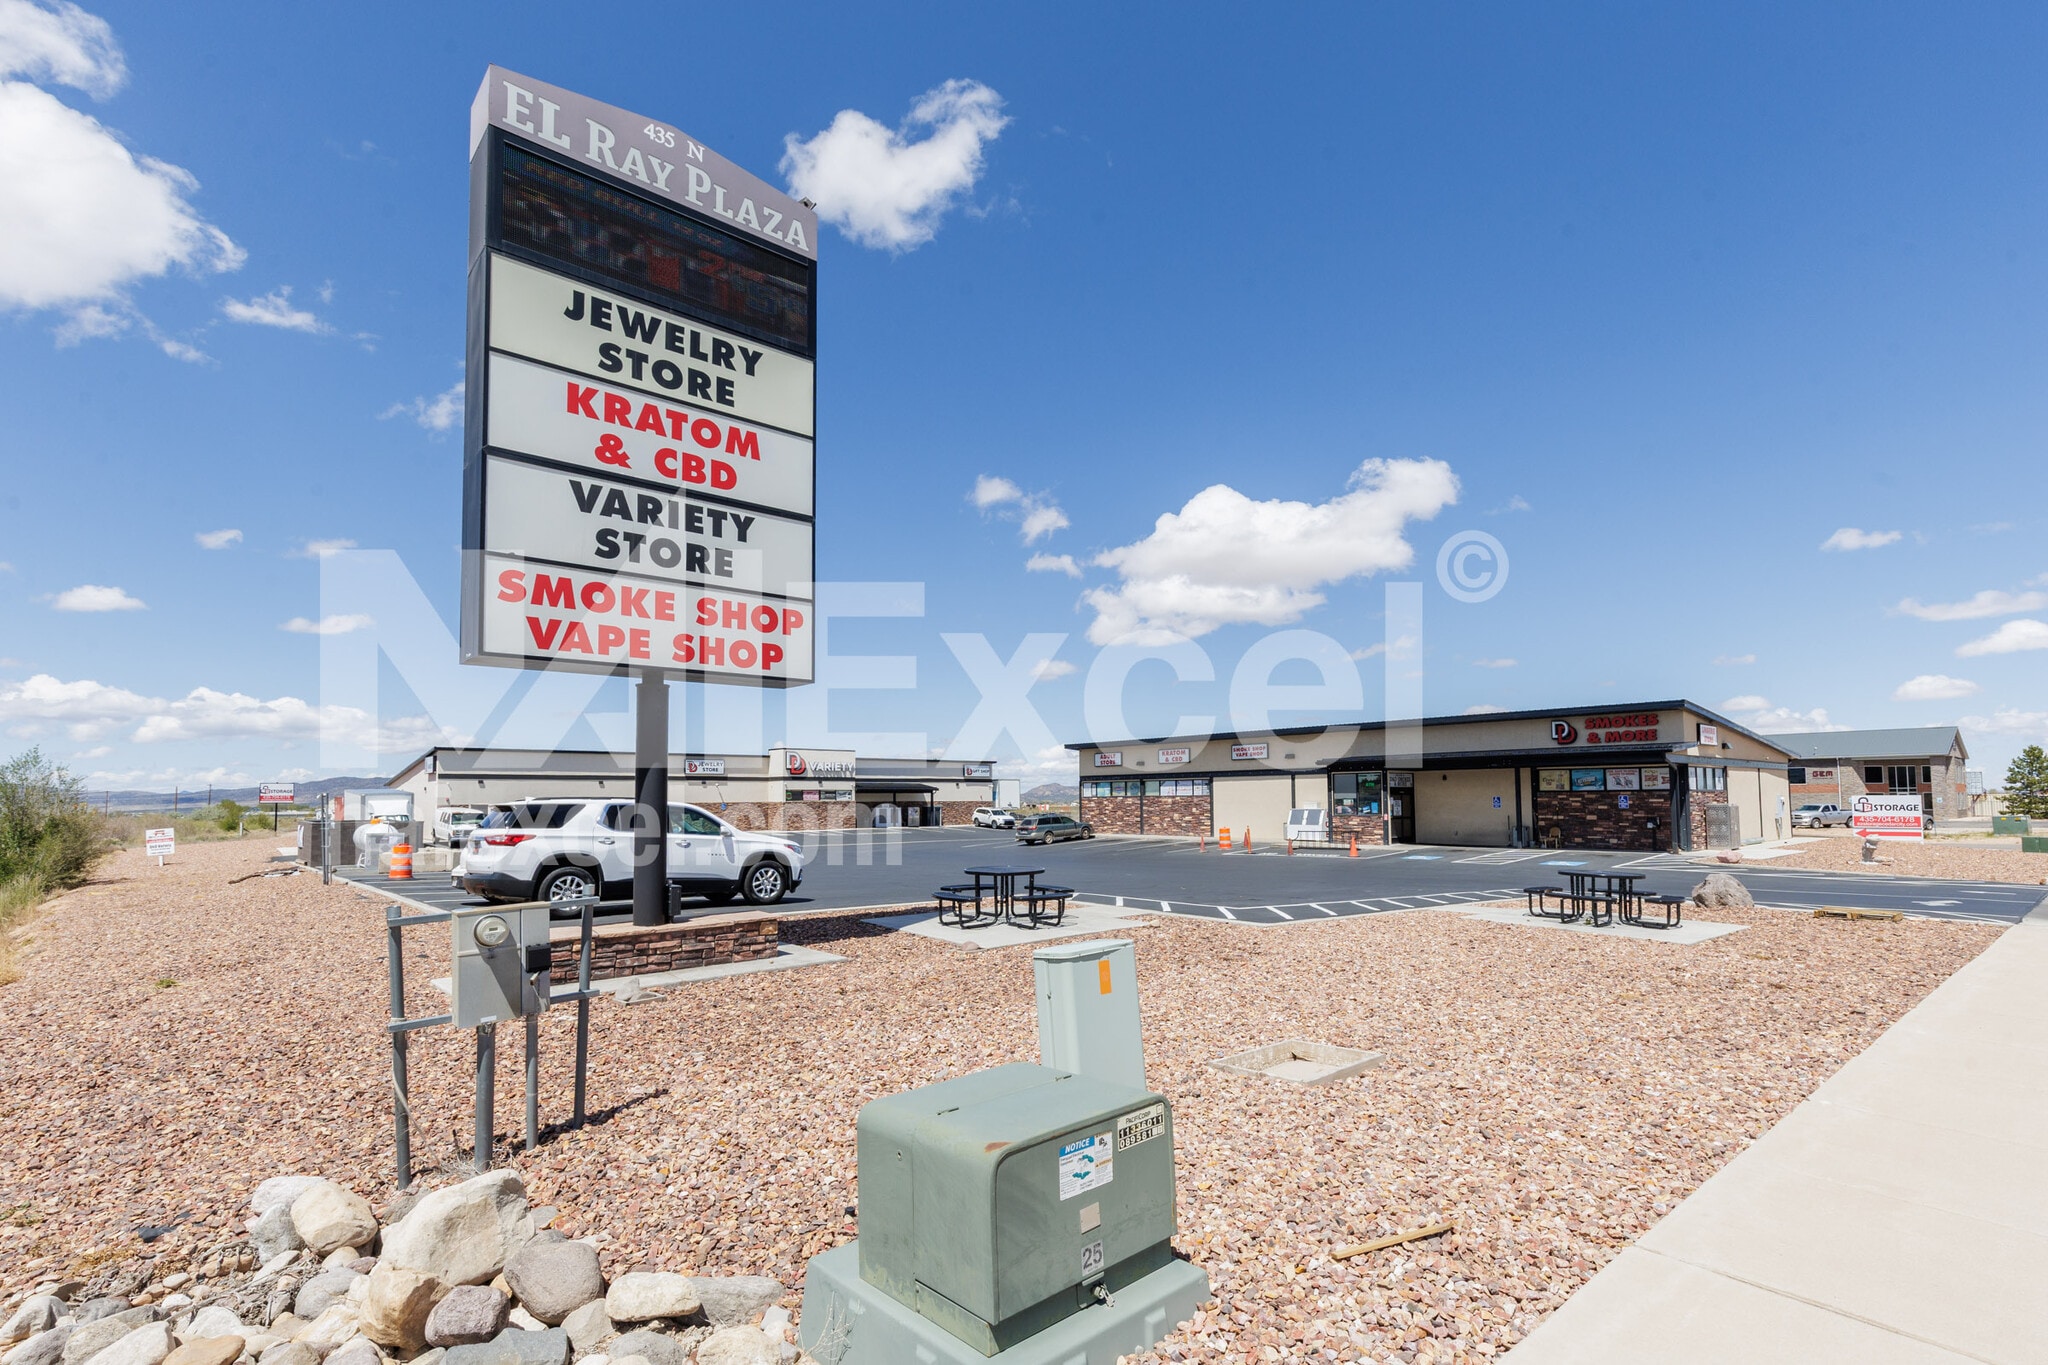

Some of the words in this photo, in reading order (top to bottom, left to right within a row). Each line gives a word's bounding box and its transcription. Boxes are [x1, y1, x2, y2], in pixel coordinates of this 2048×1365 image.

[502, 80, 571, 150] EL
[585, 117, 675, 193] RAY
[685, 163, 810, 252] PLAZA
[643, 122, 676, 148] 435
[686, 140, 705, 162] N
[563, 290, 764, 377] JEWELRY
[597, 342, 735, 407] STORE
[566, 382, 761, 461] KRATOM
[594, 433, 632, 469] &
[654, 447, 737, 491] CBD
[569, 479, 755, 543] VARIETY
[594, 528, 734, 578] STORE
[497, 568, 676, 621] SMOKE
[696, 596, 804, 636] SHOP
[525, 615, 651, 660] VAPE
[672, 633, 784, 671] SHOP
[1585, 713, 1659, 730] SMOKES
[1586, 732, 1602, 744] &
[1604, 728, 1658, 743] MORE
[808, 760, 854, 772] VARIETY
[1161, 749, 1186, 757] KRATOM
[1873, 804, 1920, 812] STORAGE
[1065, 1137, 1090, 1154] NOTICE
[1082, 1242, 1103, 1270] 25
